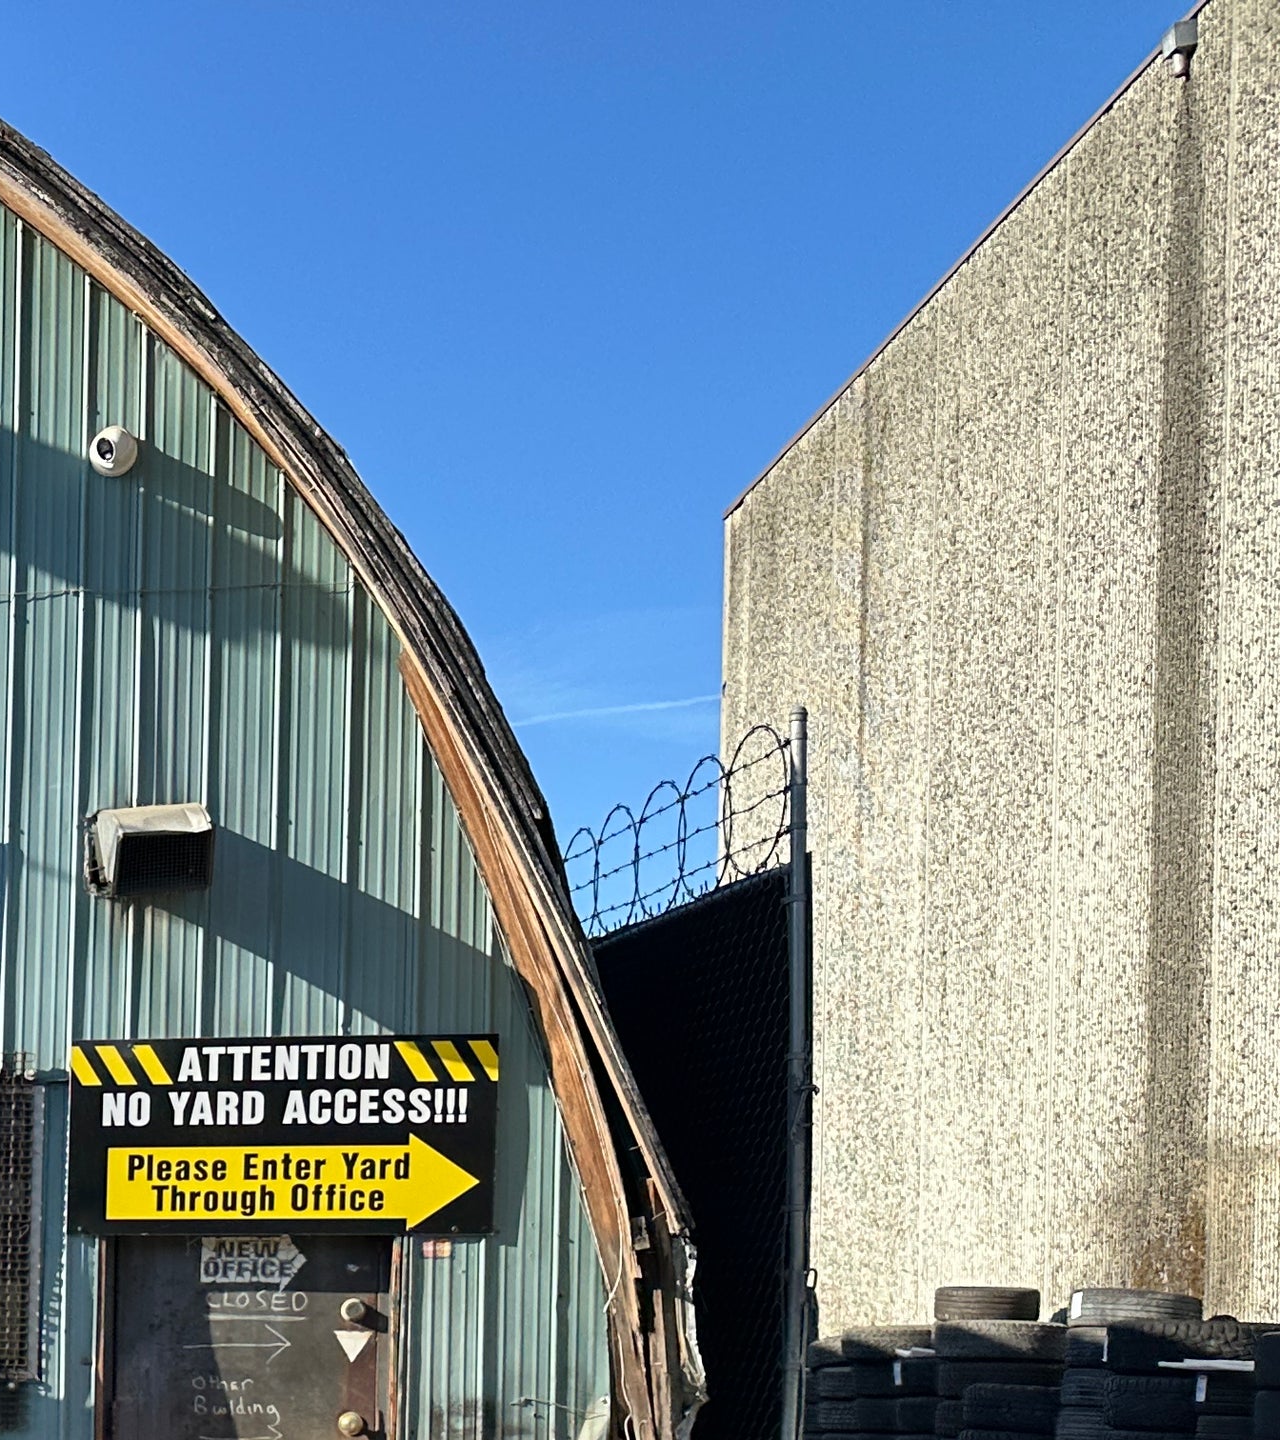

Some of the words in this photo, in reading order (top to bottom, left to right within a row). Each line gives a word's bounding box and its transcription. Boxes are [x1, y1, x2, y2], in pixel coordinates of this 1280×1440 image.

[178, 1043, 390, 1083] ATTENTION
[101, 1091, 151, 1127] NO
[168, 1090, 265, 1126] YARD
[282, 1087, 468, 1125] ACCESS!!!
[127, 1153, 227, 1181] Please
[243, 1153, 326, 1180] Enter
[341, 1152, 410, 1180] Yard
[151, 1184, 276, 1216] Through
[291, 1183, 384, 1211] Office
[217, 1239, 280, 1258] NEW
[204, 1257, 293, 1278] OFFICE
[207, 1290, 308, 1311] CLOSED
